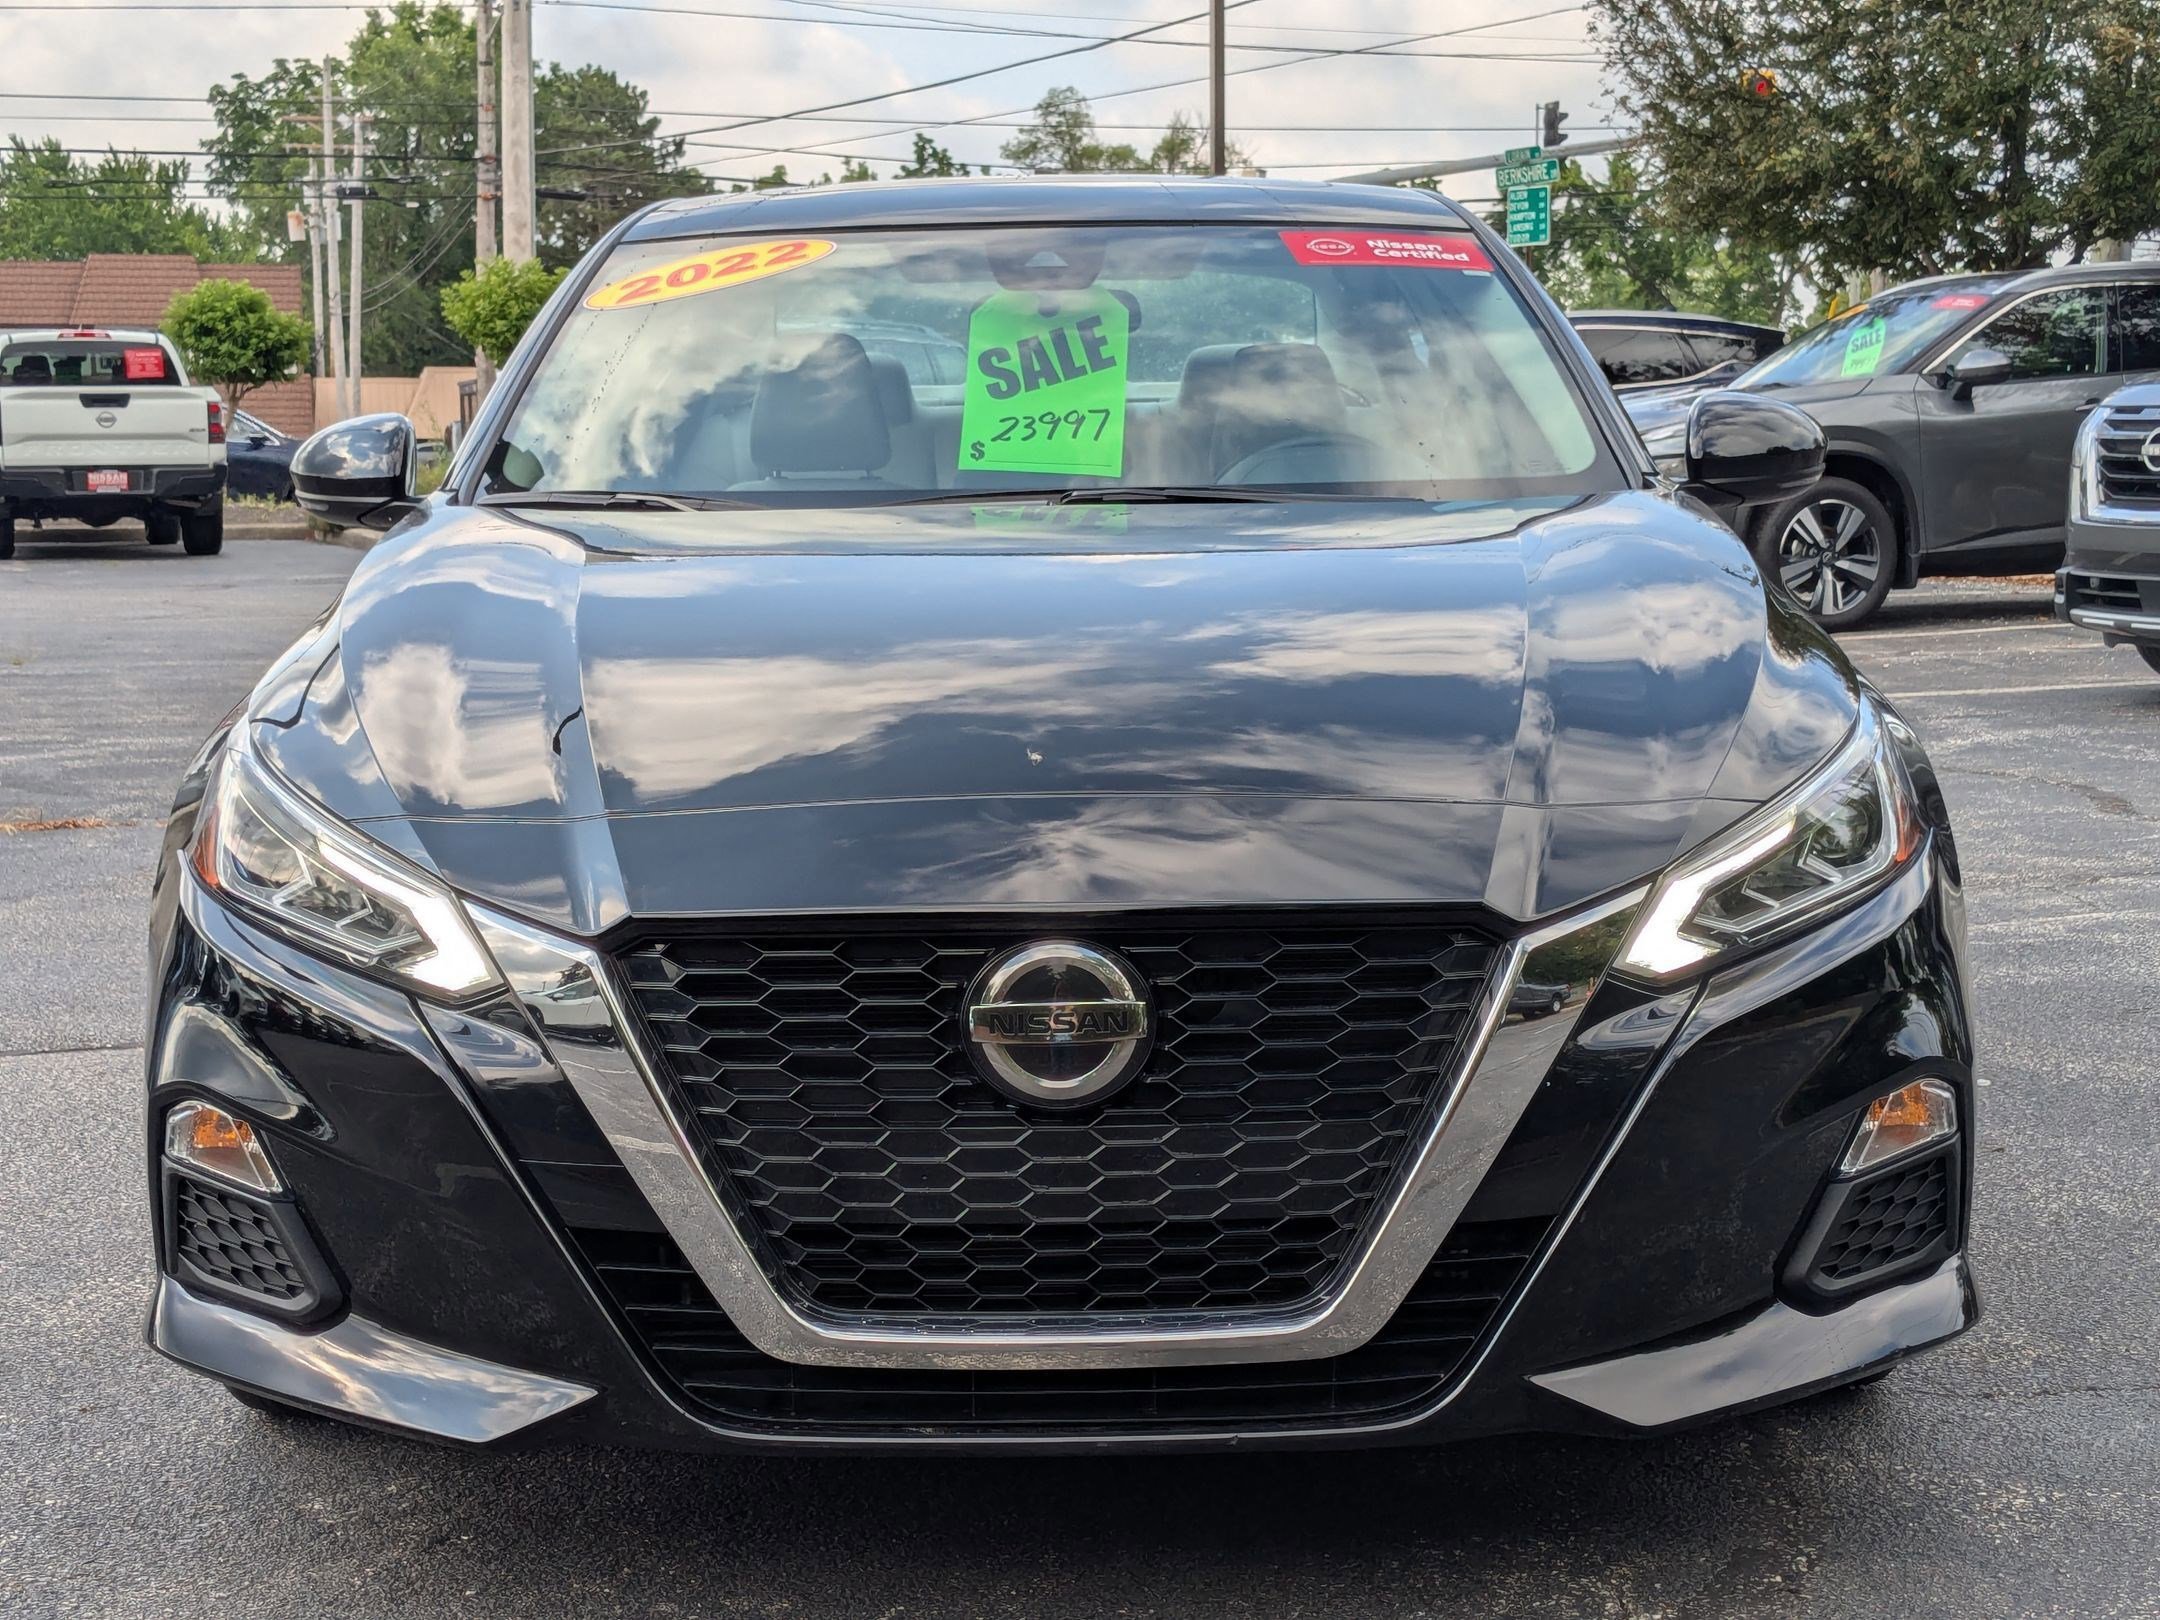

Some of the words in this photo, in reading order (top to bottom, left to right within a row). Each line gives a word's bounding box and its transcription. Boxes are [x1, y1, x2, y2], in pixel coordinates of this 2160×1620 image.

[1498, 162, 1549, 187] BERKSHIRE
[1366, 239, 1443, 252] Nissan
[1373, 248, 1470, 262] Certified
[616, 241, 809, 304] 2022
[1851, 329, 1882, 353] SALE
[978, 315, 1118, 400] SALE
[970, 440, 986, 462] $
[990, 408, 1112, 443] 23997
[88, 472, 128, 485] NISSAN
[989, 1010, 1130, 1036] NISSAN
